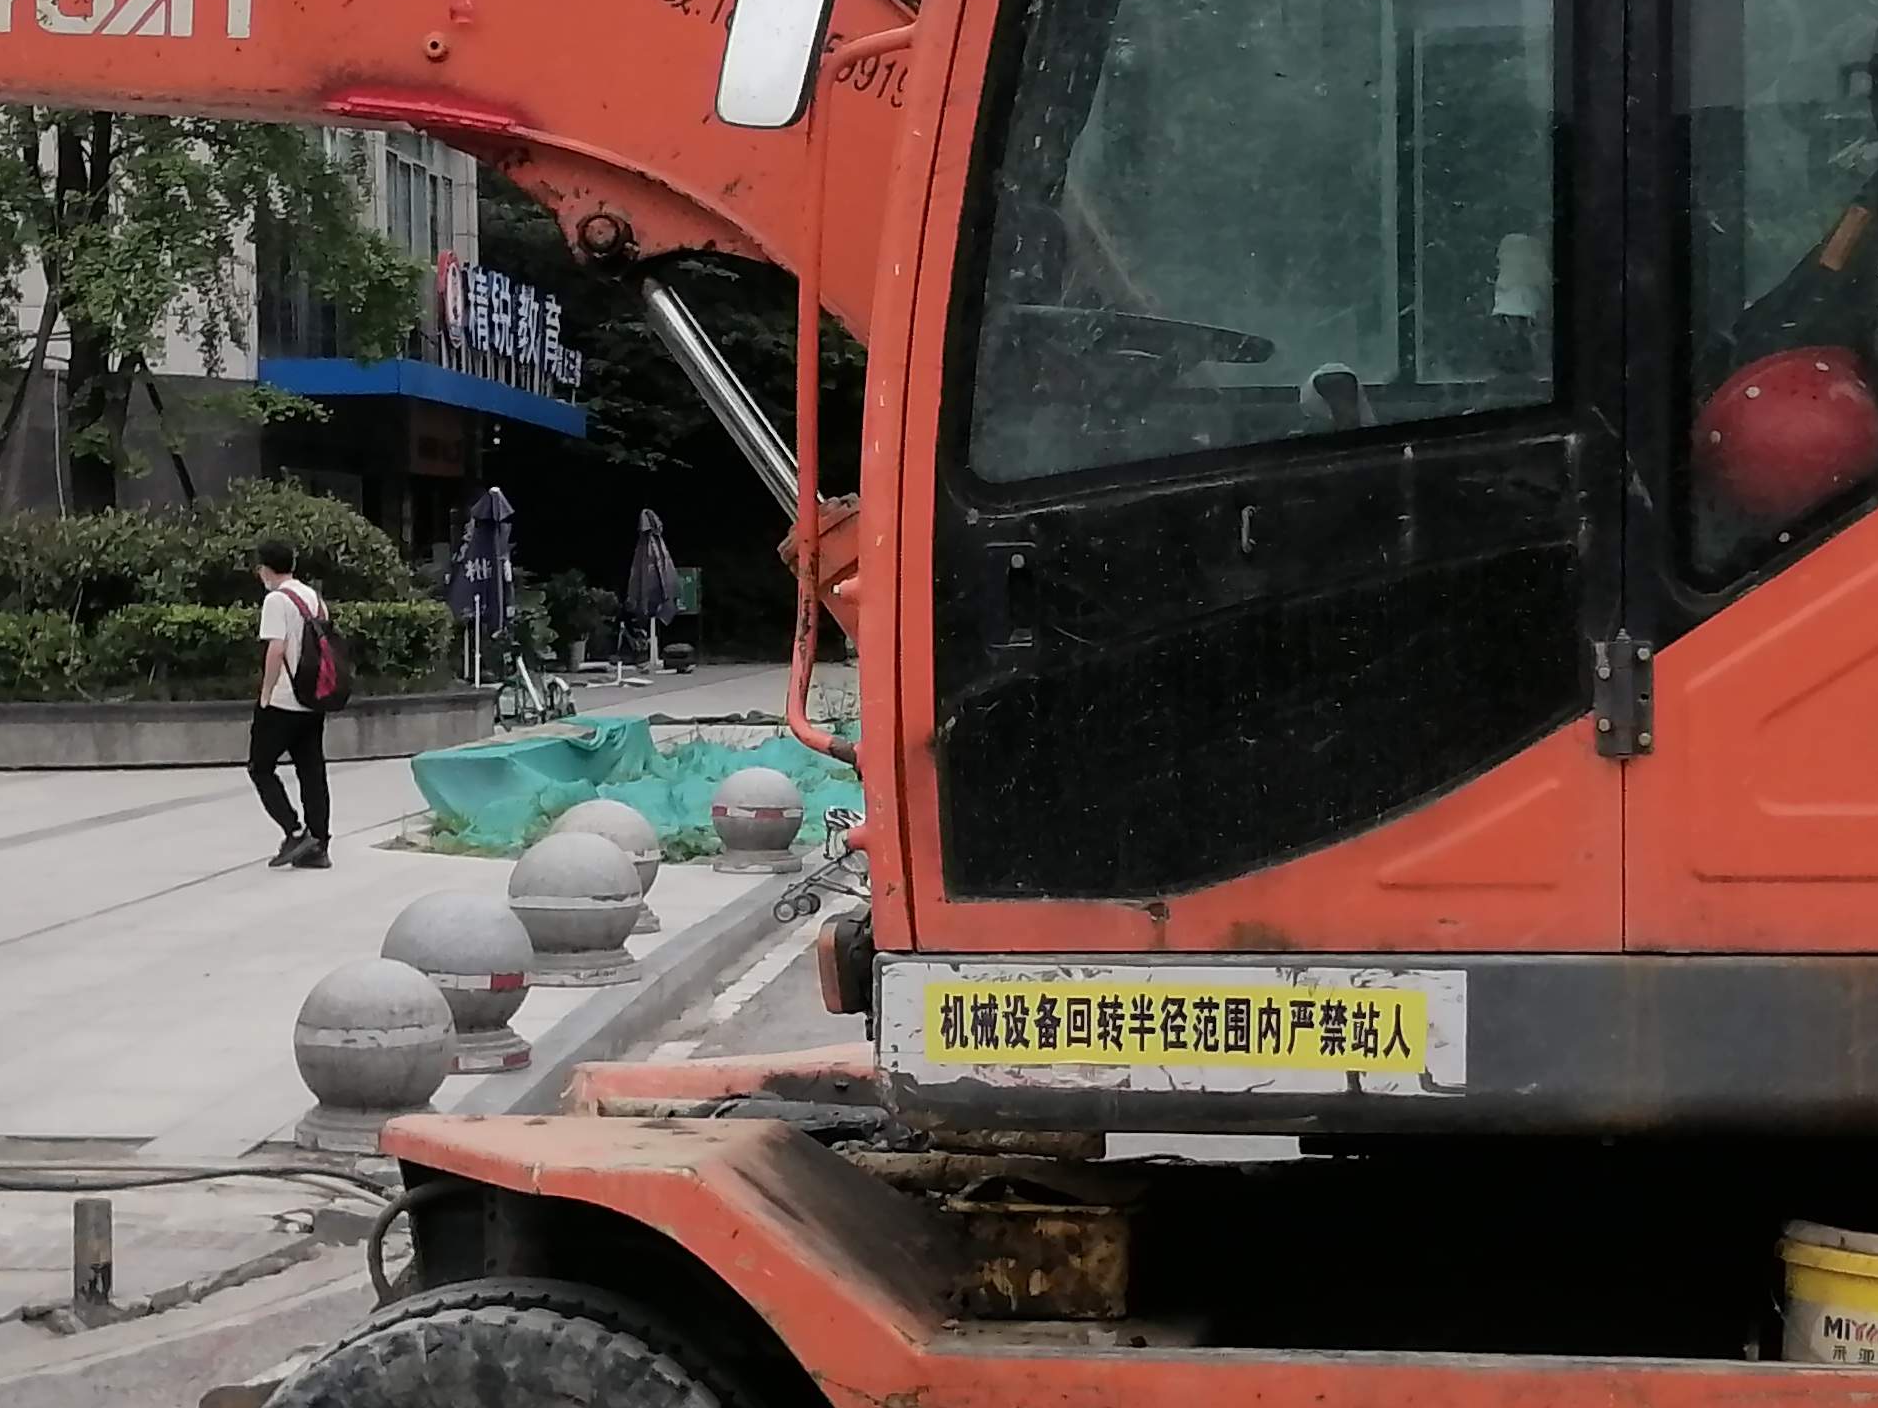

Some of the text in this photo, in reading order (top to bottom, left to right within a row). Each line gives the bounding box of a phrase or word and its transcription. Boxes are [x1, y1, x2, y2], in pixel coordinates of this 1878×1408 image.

[468, 266, 562, 373] 精锐教育
[940, 992, 1412, 1059] 机械设备回转半径范围内严禁站人
